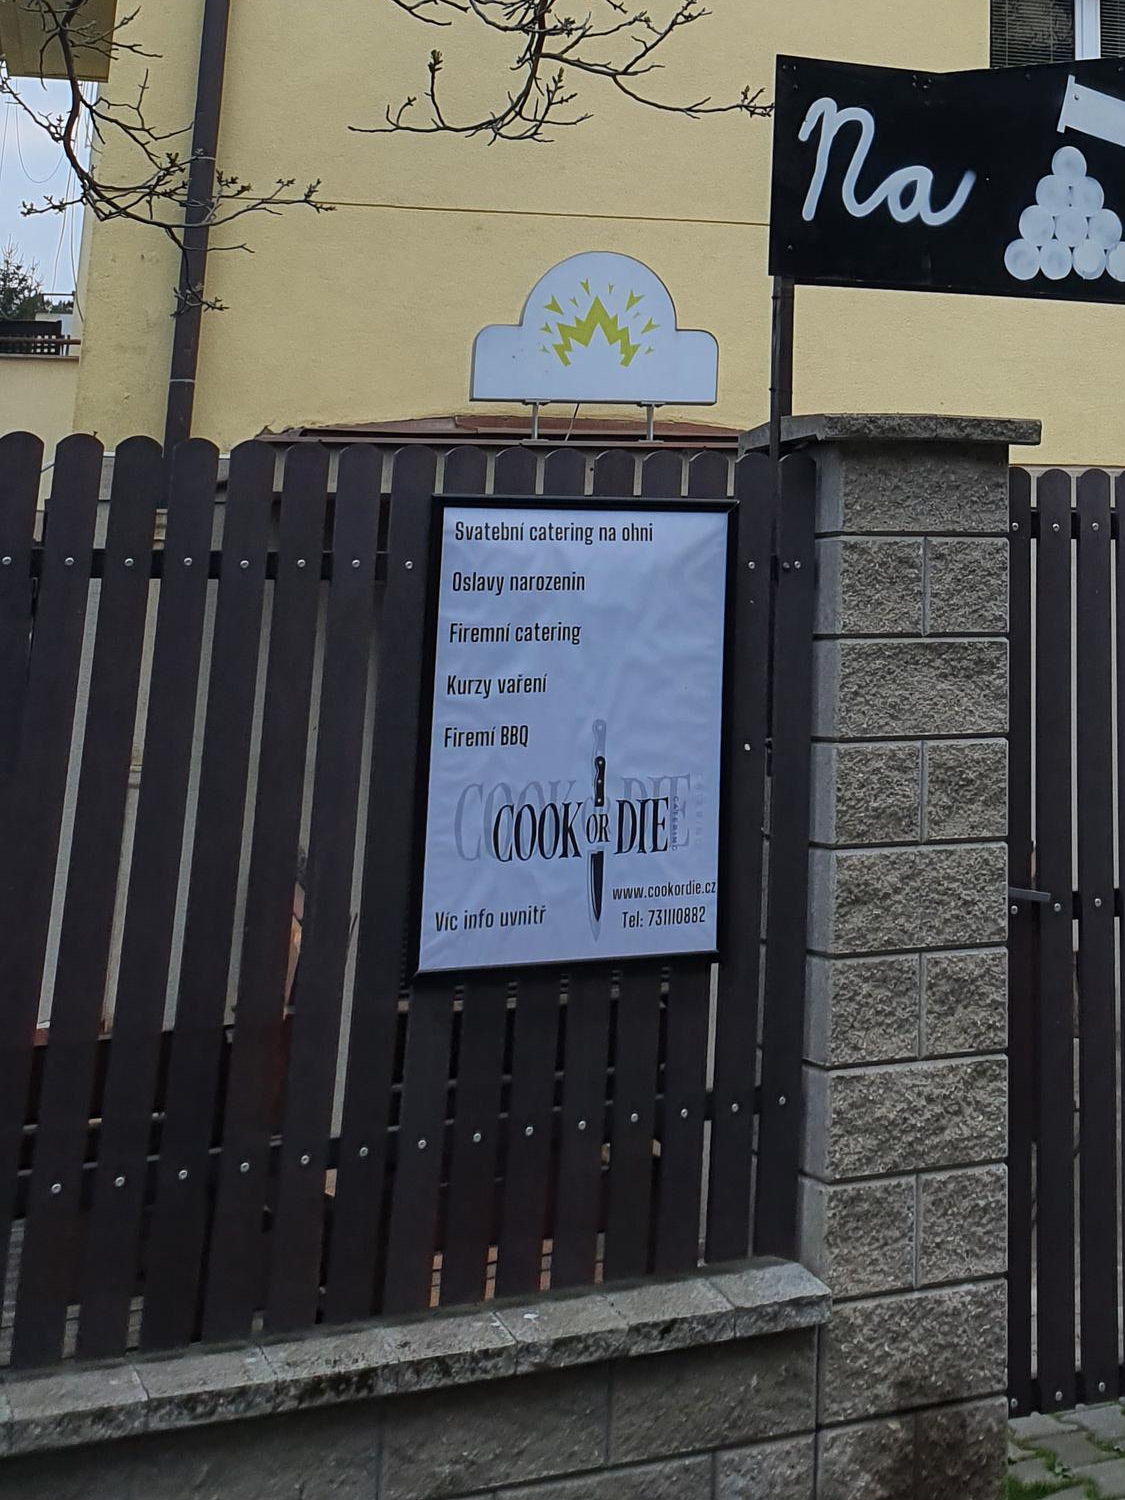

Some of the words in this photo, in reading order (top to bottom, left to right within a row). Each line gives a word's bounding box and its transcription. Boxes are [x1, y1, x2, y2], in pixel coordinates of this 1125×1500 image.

[798, 96, 975, 227] Na
[455, 521, 525, 542] Svatební
[529, 522, 594, 545] catering
[599, 527, 617, 542] na
[622, 523, 653, 542] ohni
[452, 572, 504, 596] Oslavy
[509, 571, 585, 591] narozenin
[449, 623, 511, 643] Firemní
[515, 622, 582, 645] catering
[447, 675, 491, 699] Kurzy
[497, 673, 548, 693] vaření
[444, 726, 497, 748] Firemí
[500, 725, 529, 747] BBQ
[492, 801, 585, 862] COOK
[585, 813, 610, 844] OR
[613, 797, 669, 855] DIE
[612, 880, 717, 900] www.cookordie.cz
[435, 910, 458, 932] Víc
[463, 908, 494, 930] info
[499, 904, 547, 927] uvnitř
[622, 910, 644, 928] Tel:
[648, 906, 706, 927] 731110882
